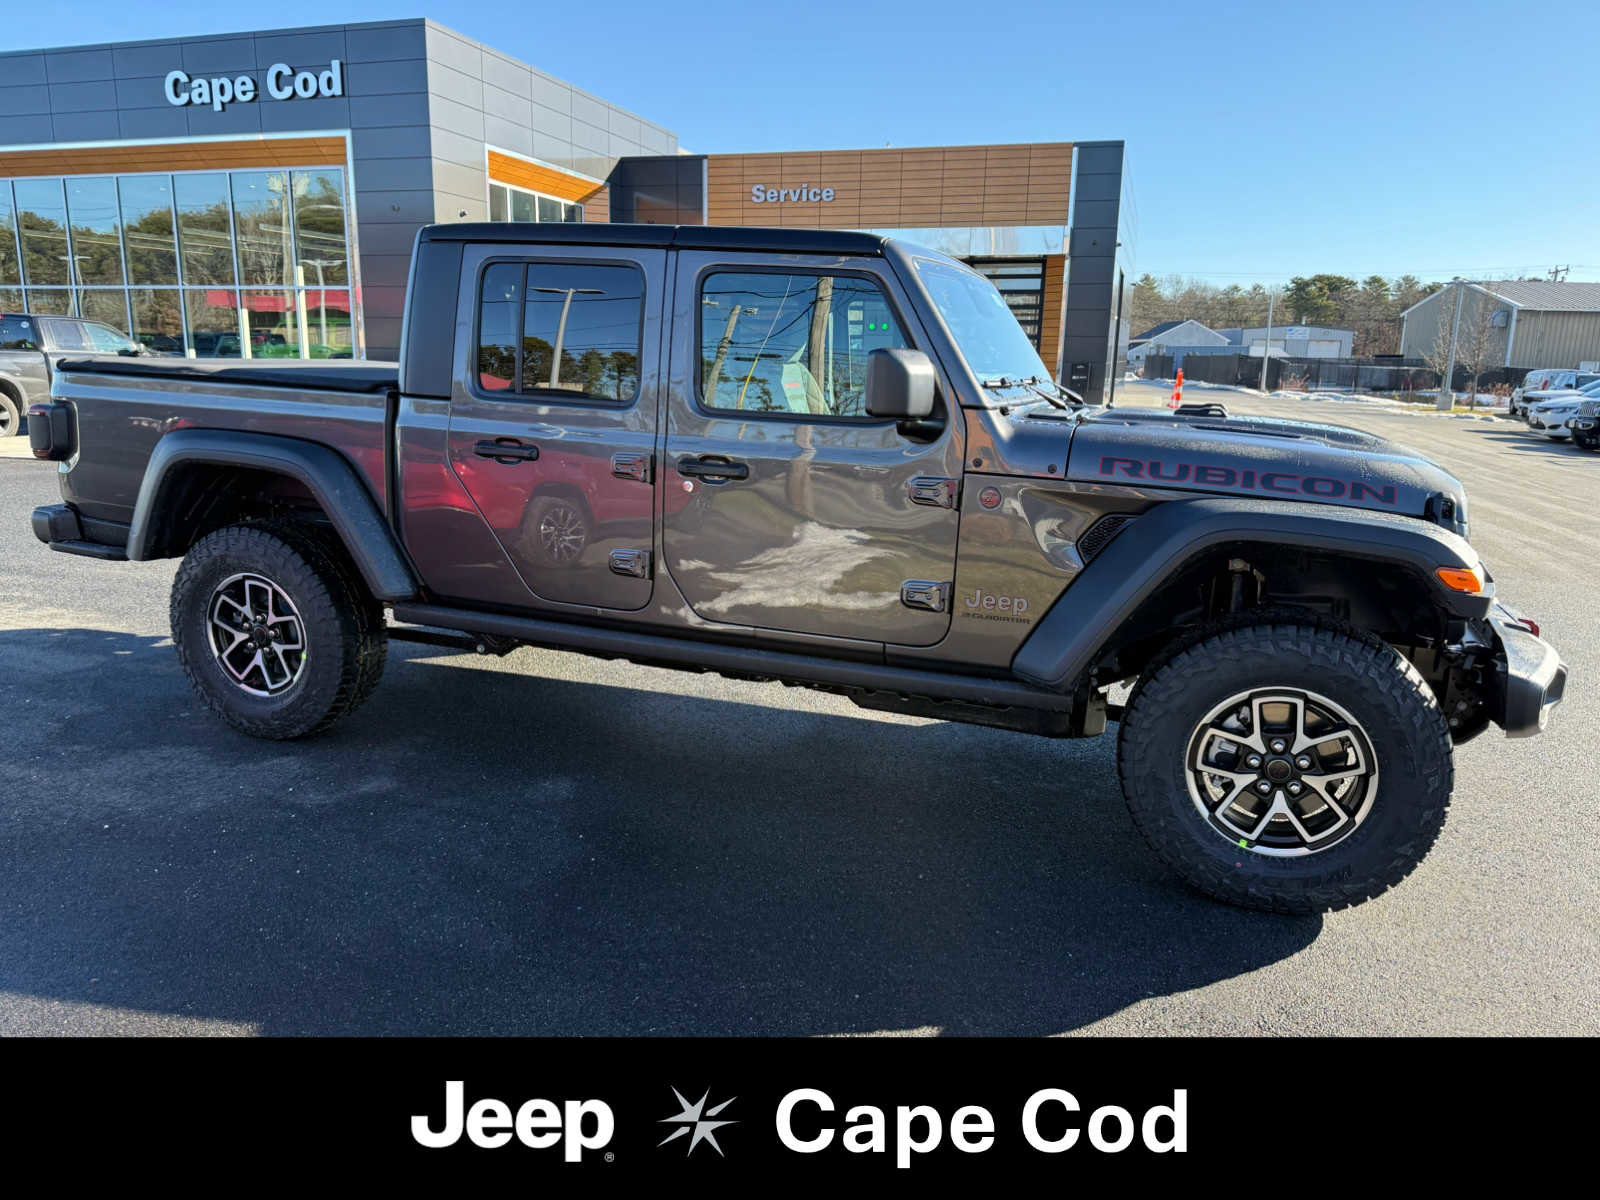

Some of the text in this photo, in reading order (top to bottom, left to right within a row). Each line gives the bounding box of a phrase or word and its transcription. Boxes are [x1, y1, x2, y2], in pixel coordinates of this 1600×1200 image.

[165, 60, 343, 112] Cape Cod
[752, 183, 834, 203] Service
[1099, 456, 1397, 505] RUBICON
[965, 589, 1028, 616] Jeep
